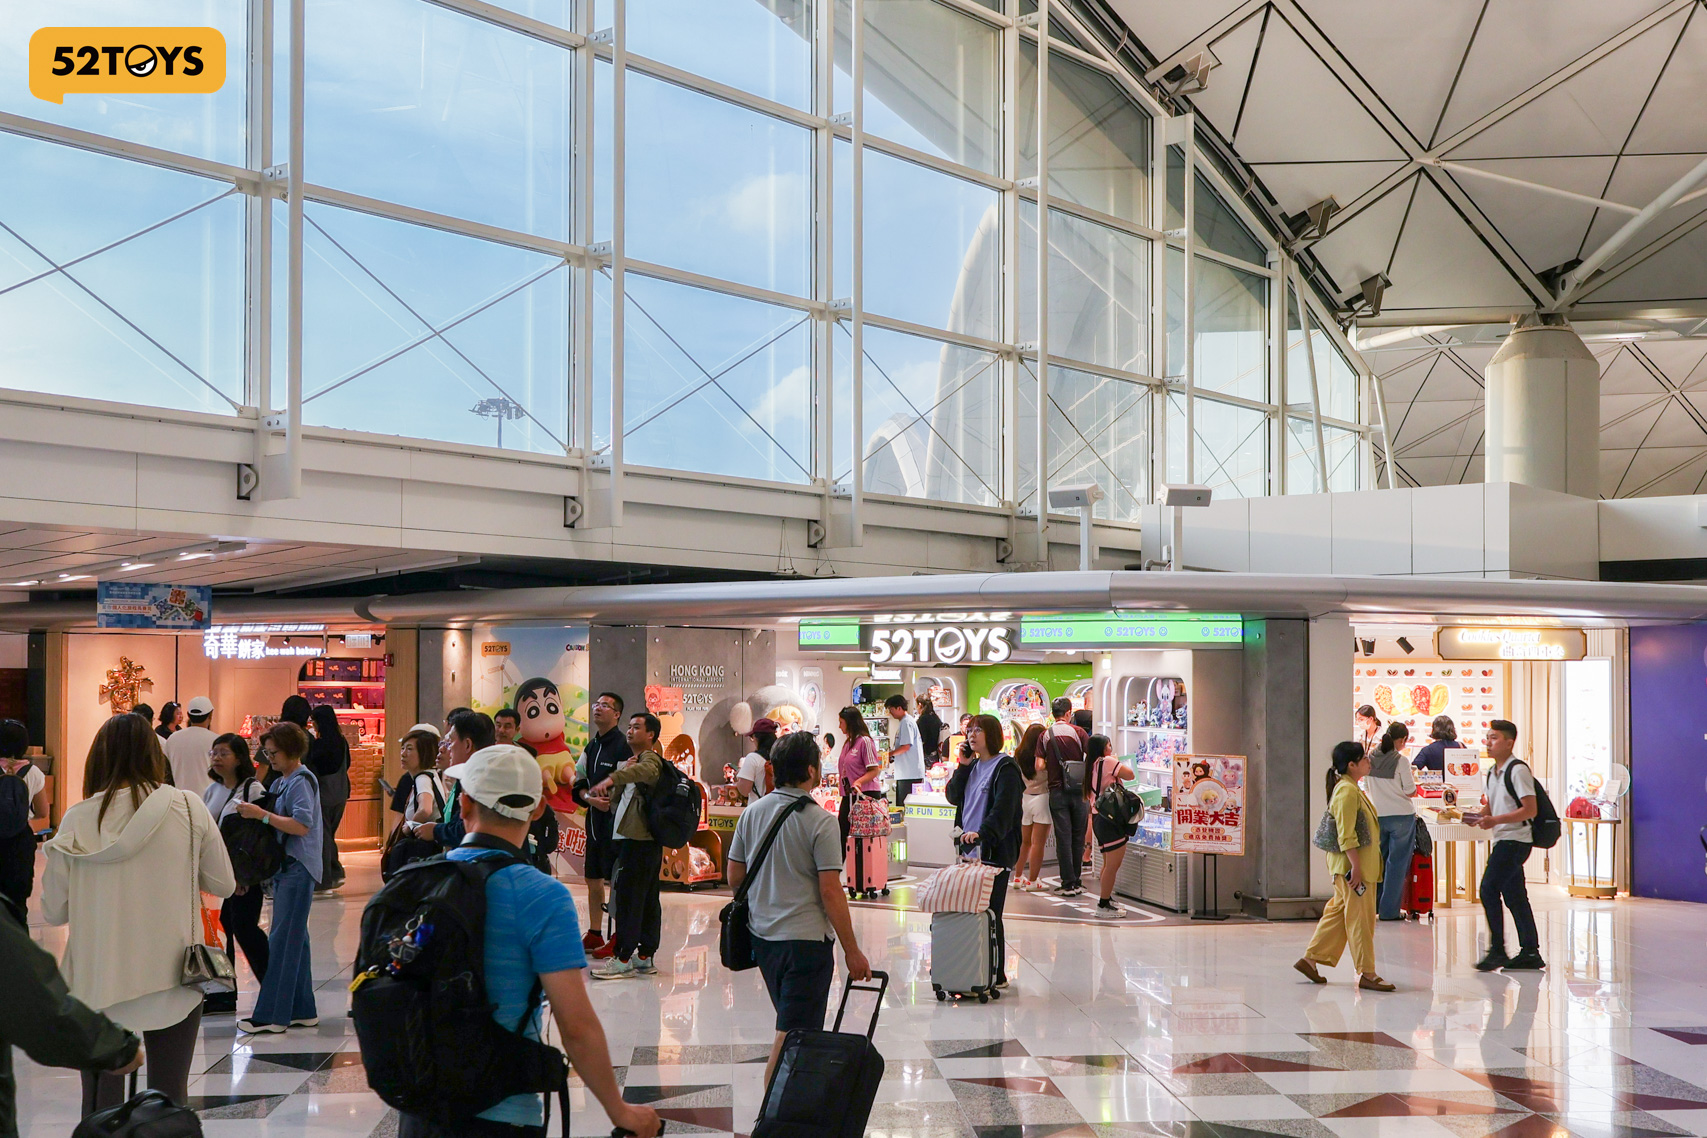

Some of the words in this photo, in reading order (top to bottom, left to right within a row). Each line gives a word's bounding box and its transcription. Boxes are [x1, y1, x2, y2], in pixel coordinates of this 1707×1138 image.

[1029, 627, 1063, 638] 52TOYS
[1116, 626, 1156, 637] 52TOYS
[203, 631, 266, 660] 奇華餅家
[484, 645, 508, 653] 52TOYS
[870, 626, 1011, 664] 52TOYS
[295, 646, 322, 657] bakery
[670, 664, 698, 677] HONG
[699, 665, 725, 677] KONG
[682, 693, 713, 705] 52TOYS
[917, 807, 933, 816] FUN
[939, 808, 956, 817] 52T
[1176, 809, 1240, 827] 開業大吉
